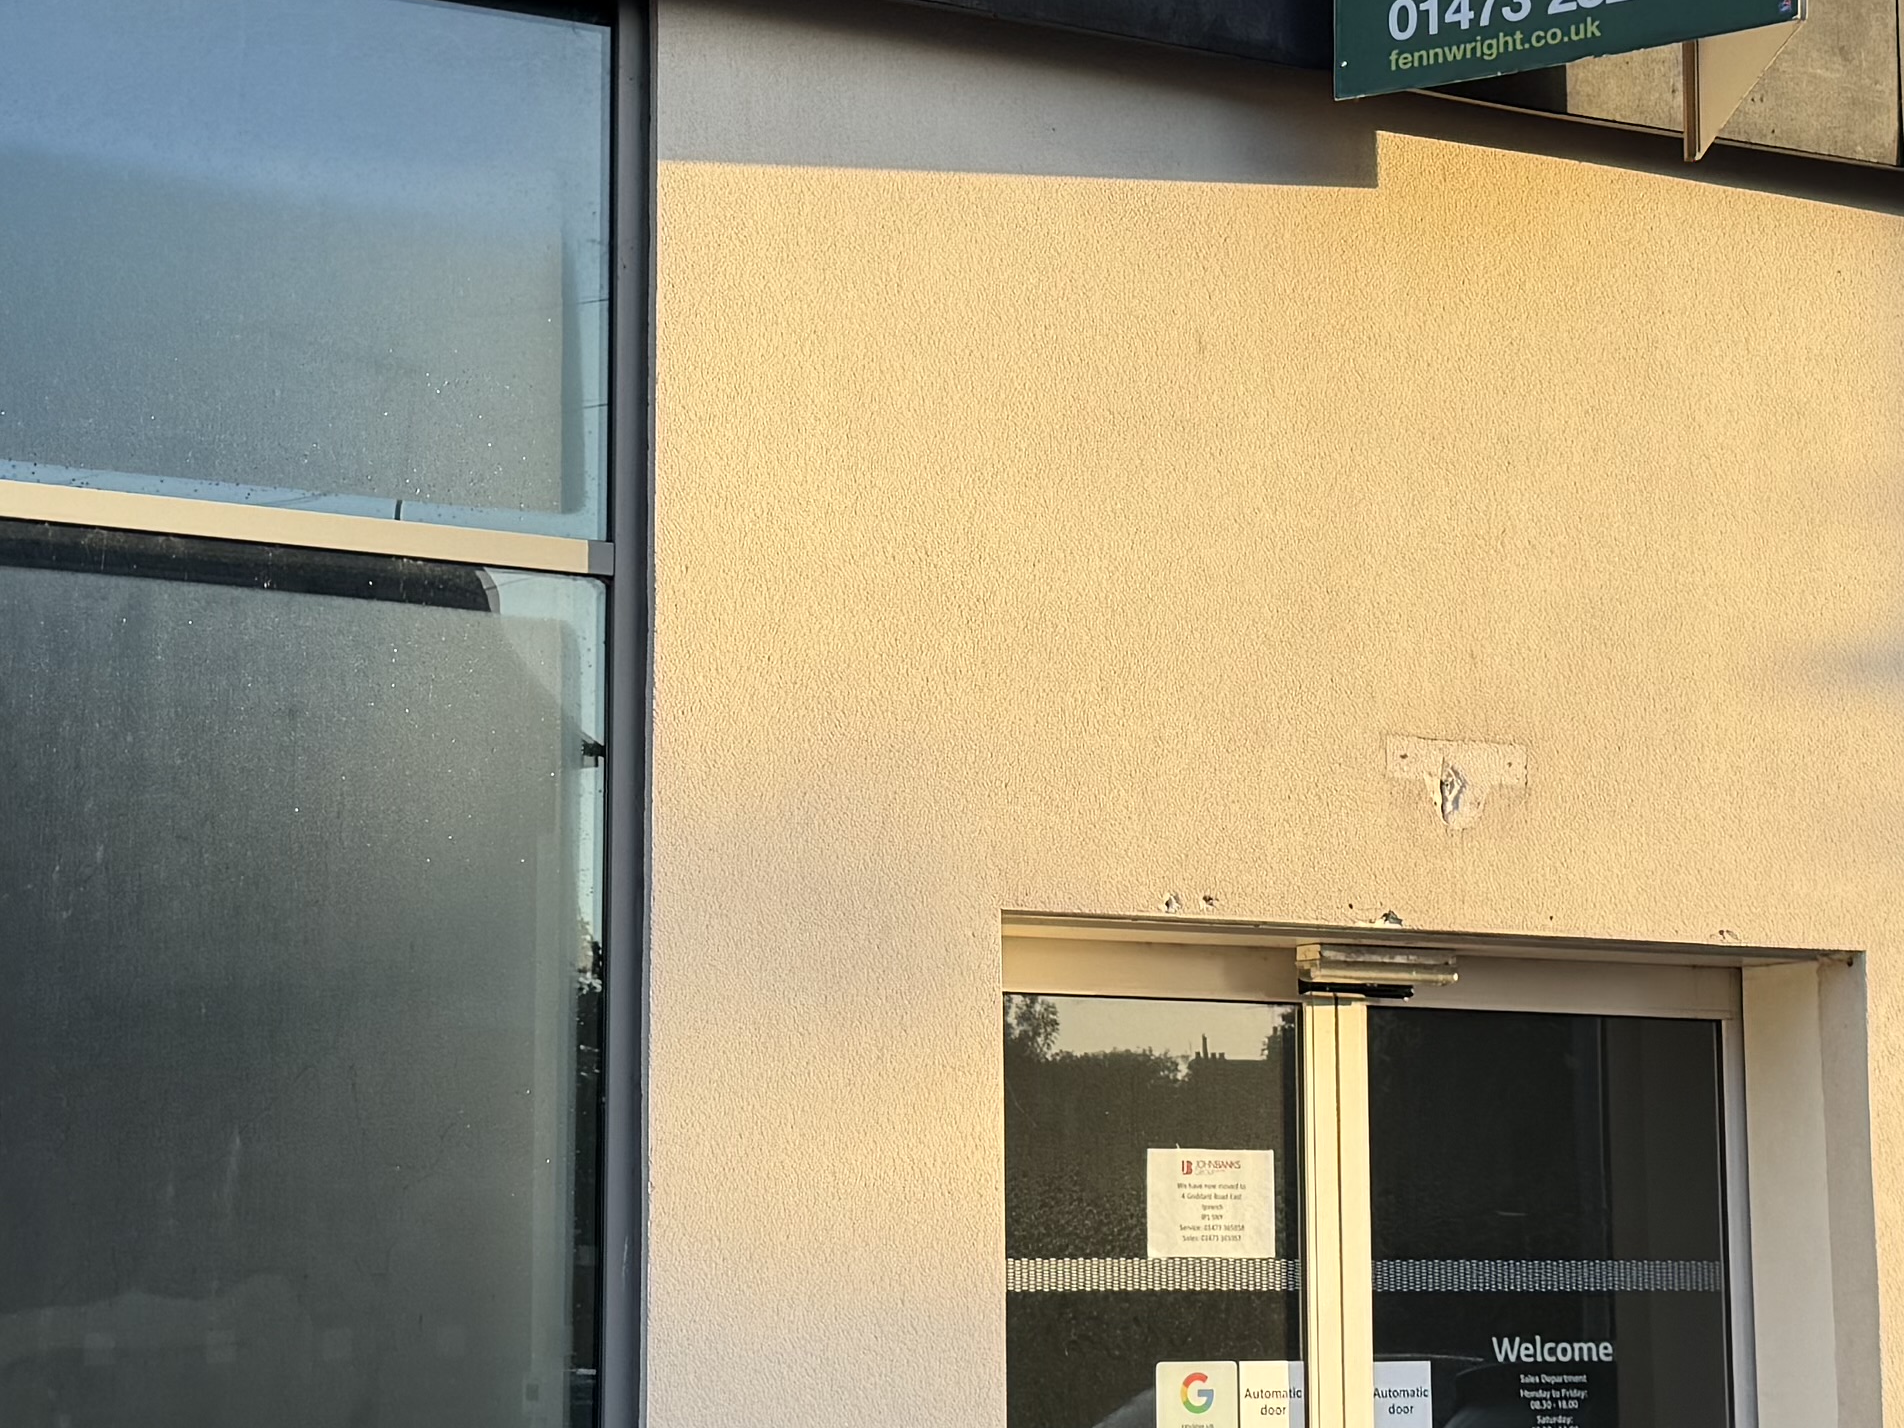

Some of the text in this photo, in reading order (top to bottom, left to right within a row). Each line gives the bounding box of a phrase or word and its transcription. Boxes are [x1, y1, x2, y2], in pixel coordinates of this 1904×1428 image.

[1388, 16, 1601, 71] fennwright.co.uk
[1492, 1335, 1614, 1362] Welcome
[1541, 1374, 1587, 1384] Department
[1244, 1388, 1303, 1400] Automatic
[1373, 1386, 1429, 1399] Automatic
[1519, 1389, 1551, 1399] Monday
[1552, 1389, 1560, 1398] to
[1260, 1405, 1287, 1416] door
[1388, 1403, 1414, 1415] door
